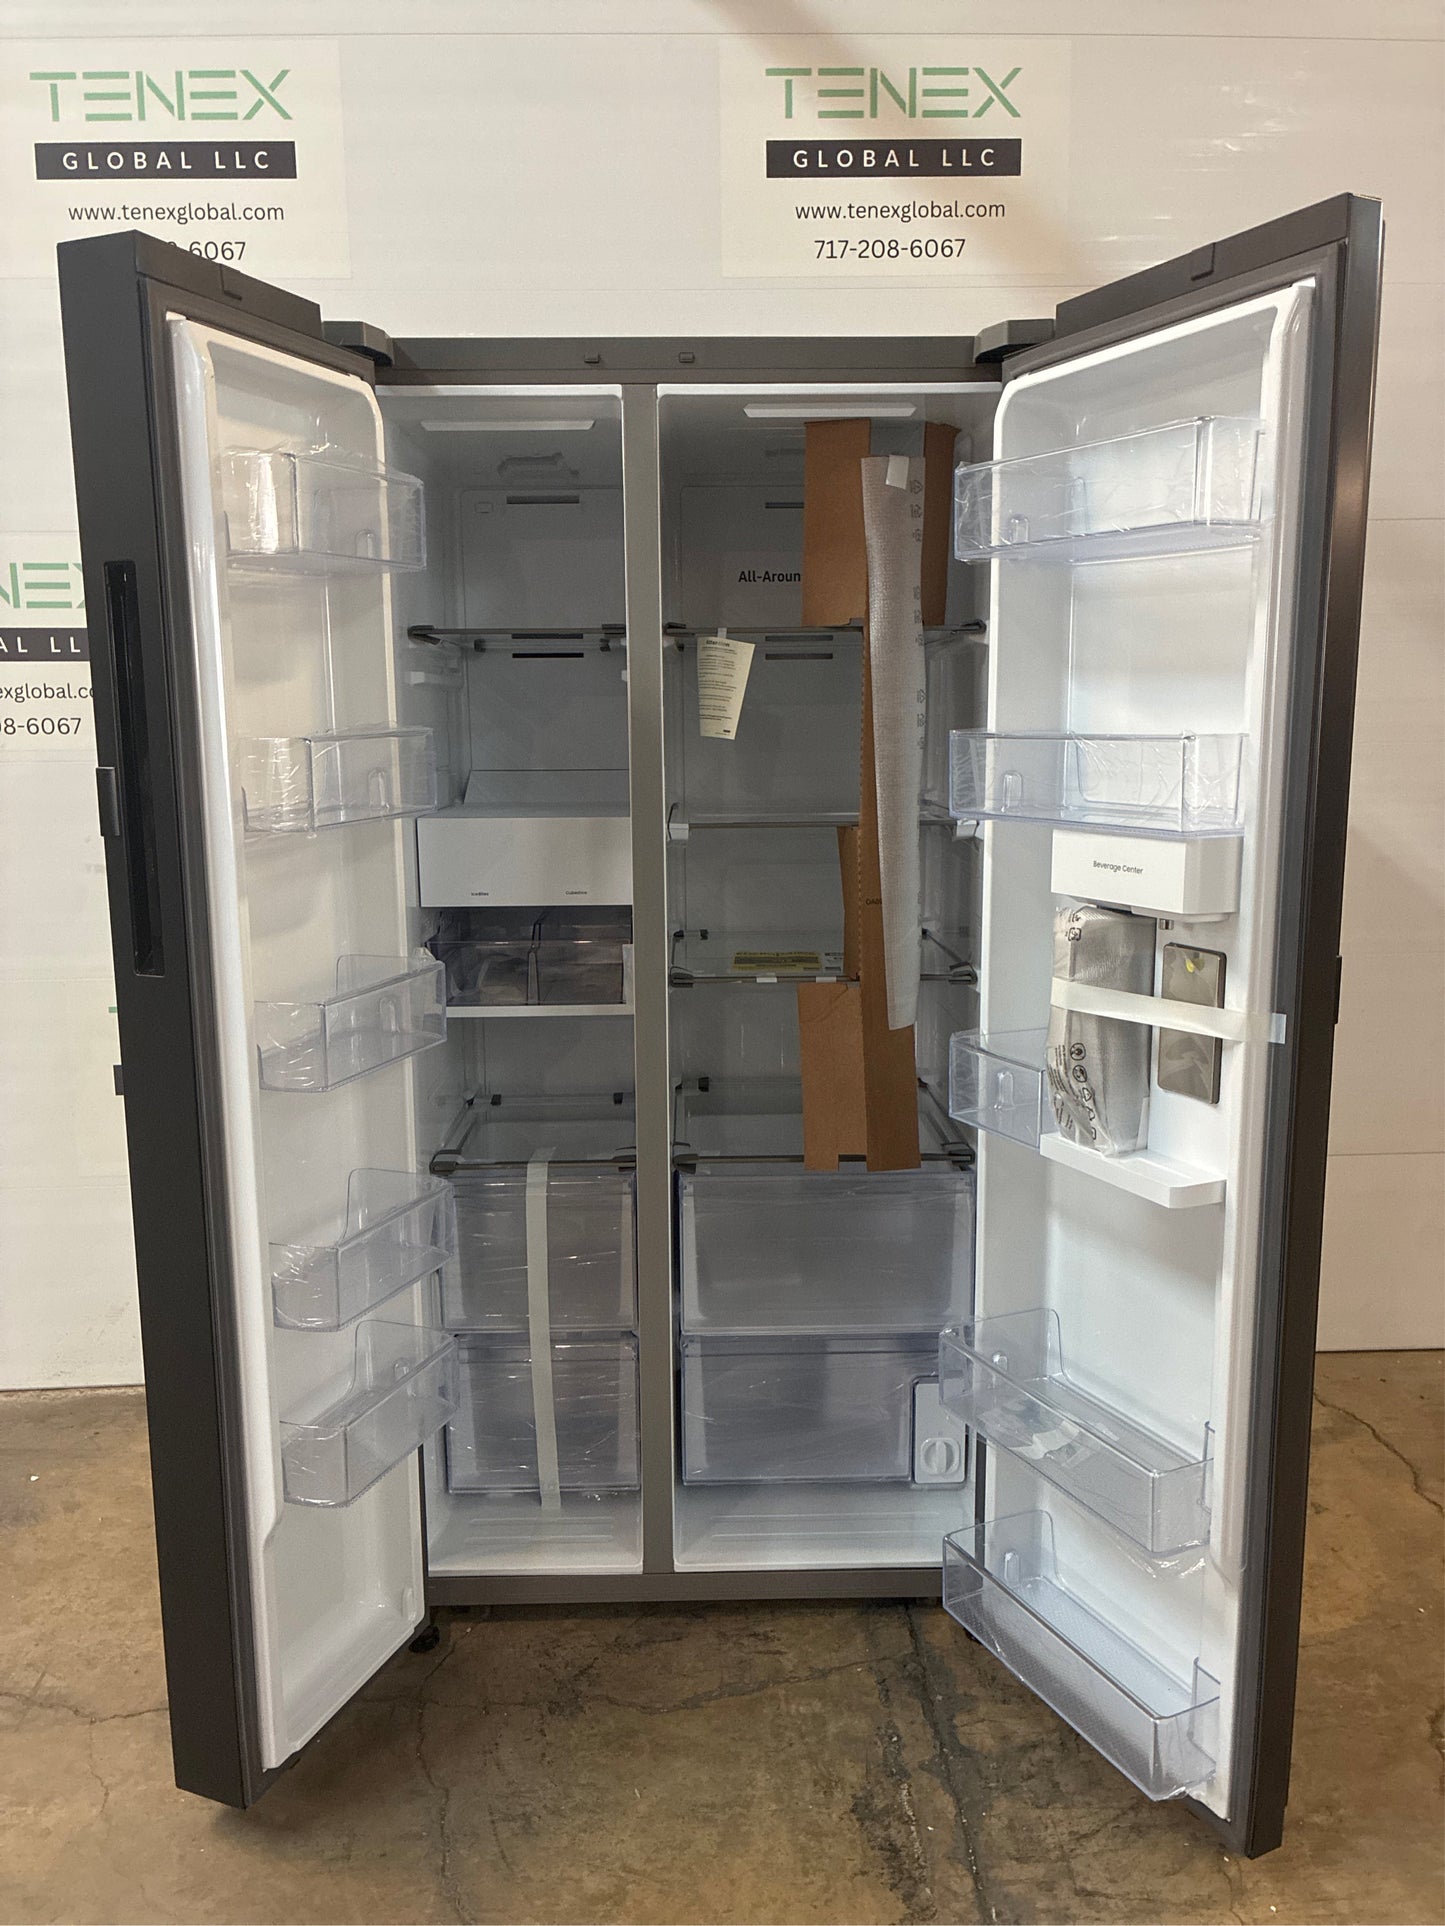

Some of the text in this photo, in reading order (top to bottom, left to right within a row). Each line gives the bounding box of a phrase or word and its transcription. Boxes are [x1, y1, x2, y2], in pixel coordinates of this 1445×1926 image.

[29, 69, 293, 122] TENEX
[766, 67, 1023, 119] TENEX
[62, 151, 270, 170] GLOBAL LLC
[793, 148, 995, 168] GLOBAL LLC
[68, 203, 285, 224] www.tenexglobal.com
[795, 200, 1006, 222] www.tenexglobal.com
[168, 241, 246, 261] 6067
[814, 239, 966, 259] 717-208-6067
[738, 570, 801, 583] All-Aroun
[50, 636, 81, 653] LL
[0, 718, 82, 735] 8-6067
[1093, 860, 1143, 874] Beverage Center
